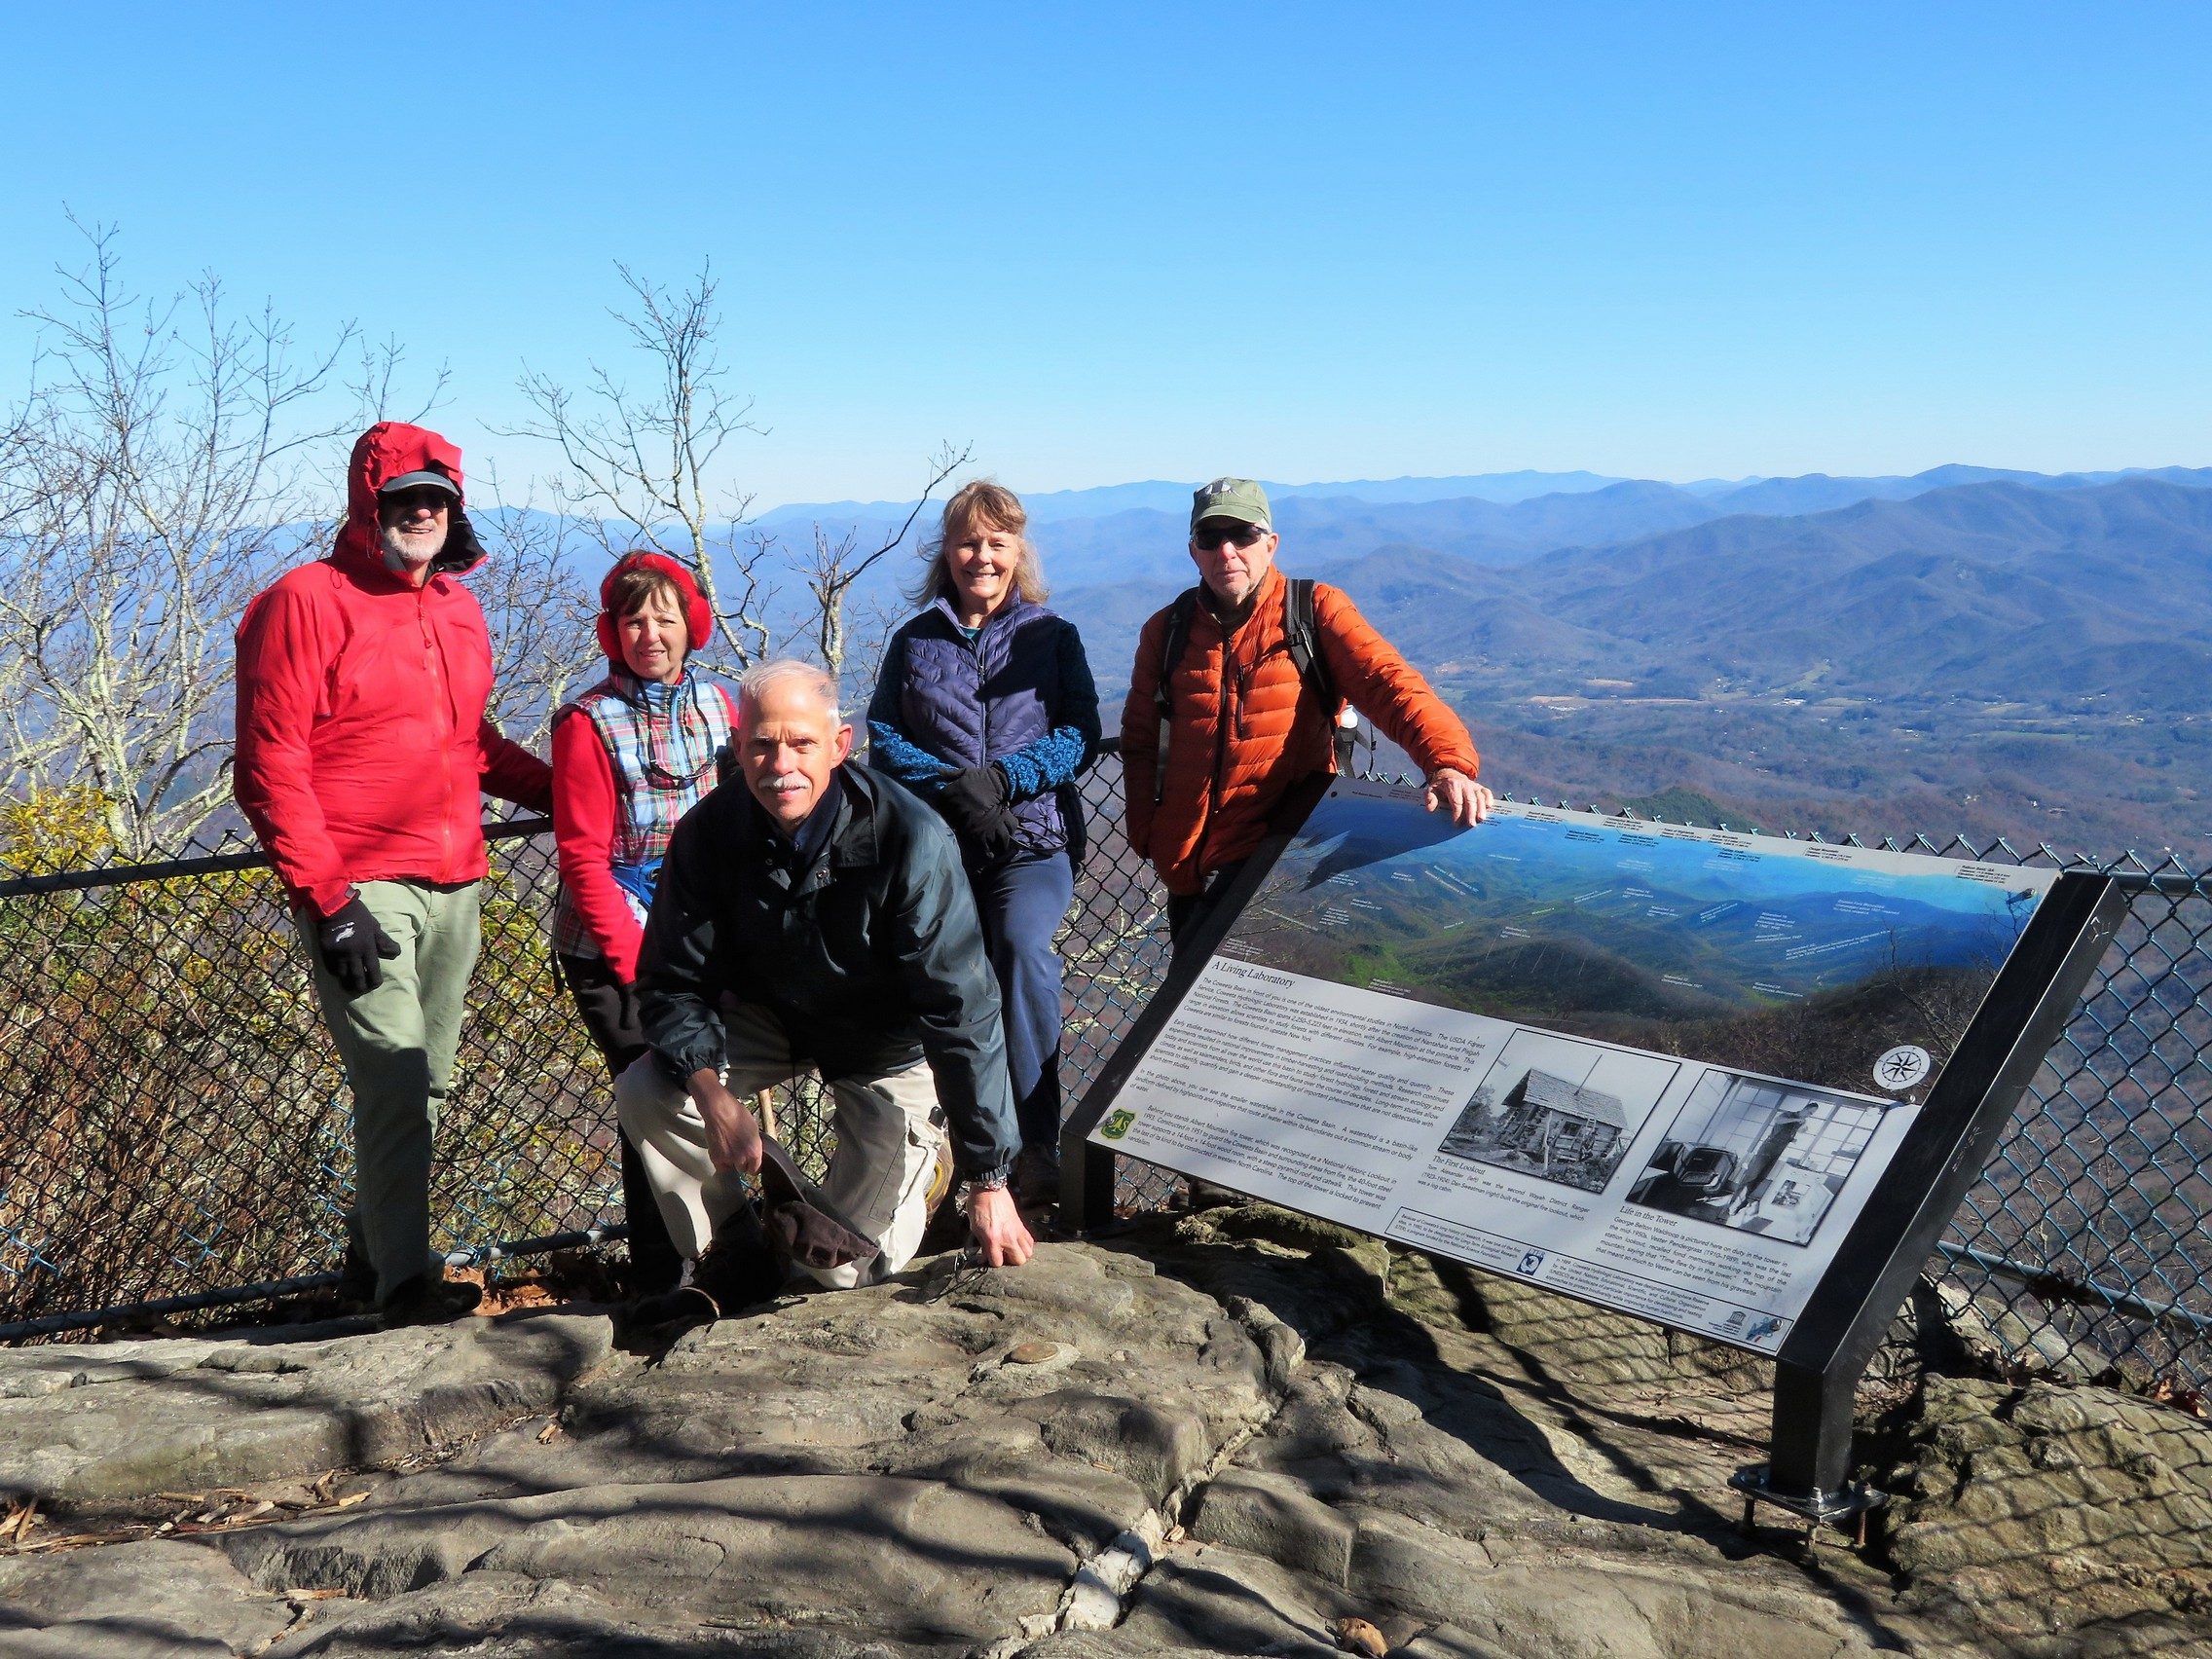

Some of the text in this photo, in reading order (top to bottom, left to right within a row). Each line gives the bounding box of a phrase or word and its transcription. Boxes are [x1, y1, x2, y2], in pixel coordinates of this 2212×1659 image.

[1211, 960, 1297, 990] A Living Laboratory
[1432, 1155, 1487, 1175] The First Lookout
[1619, 1205, 1679, 1227] Life in the Tower
